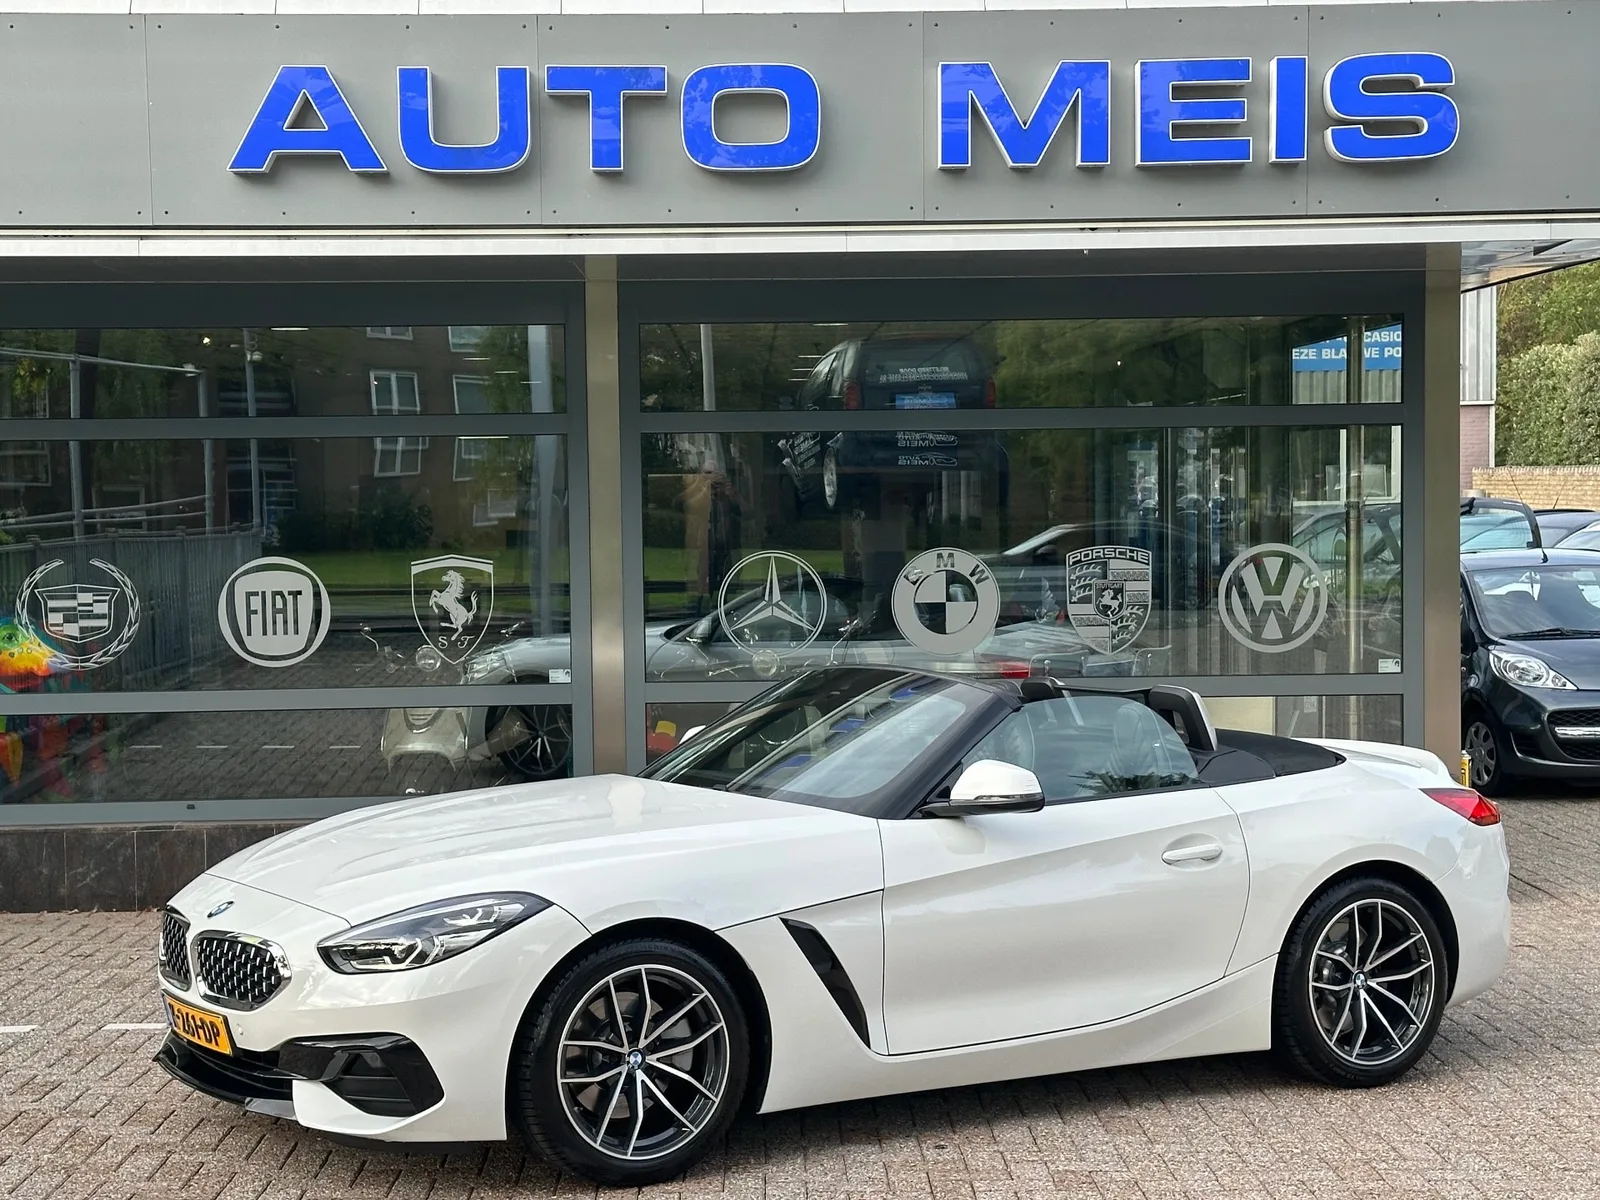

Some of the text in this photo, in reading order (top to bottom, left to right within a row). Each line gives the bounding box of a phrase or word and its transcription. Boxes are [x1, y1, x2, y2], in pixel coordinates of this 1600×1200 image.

[227, 52, 1460, 174] AUTO MEIS
[1070, 548, 1149, 565] PORSCHE
[244, 590, 303, 637] FIAT
